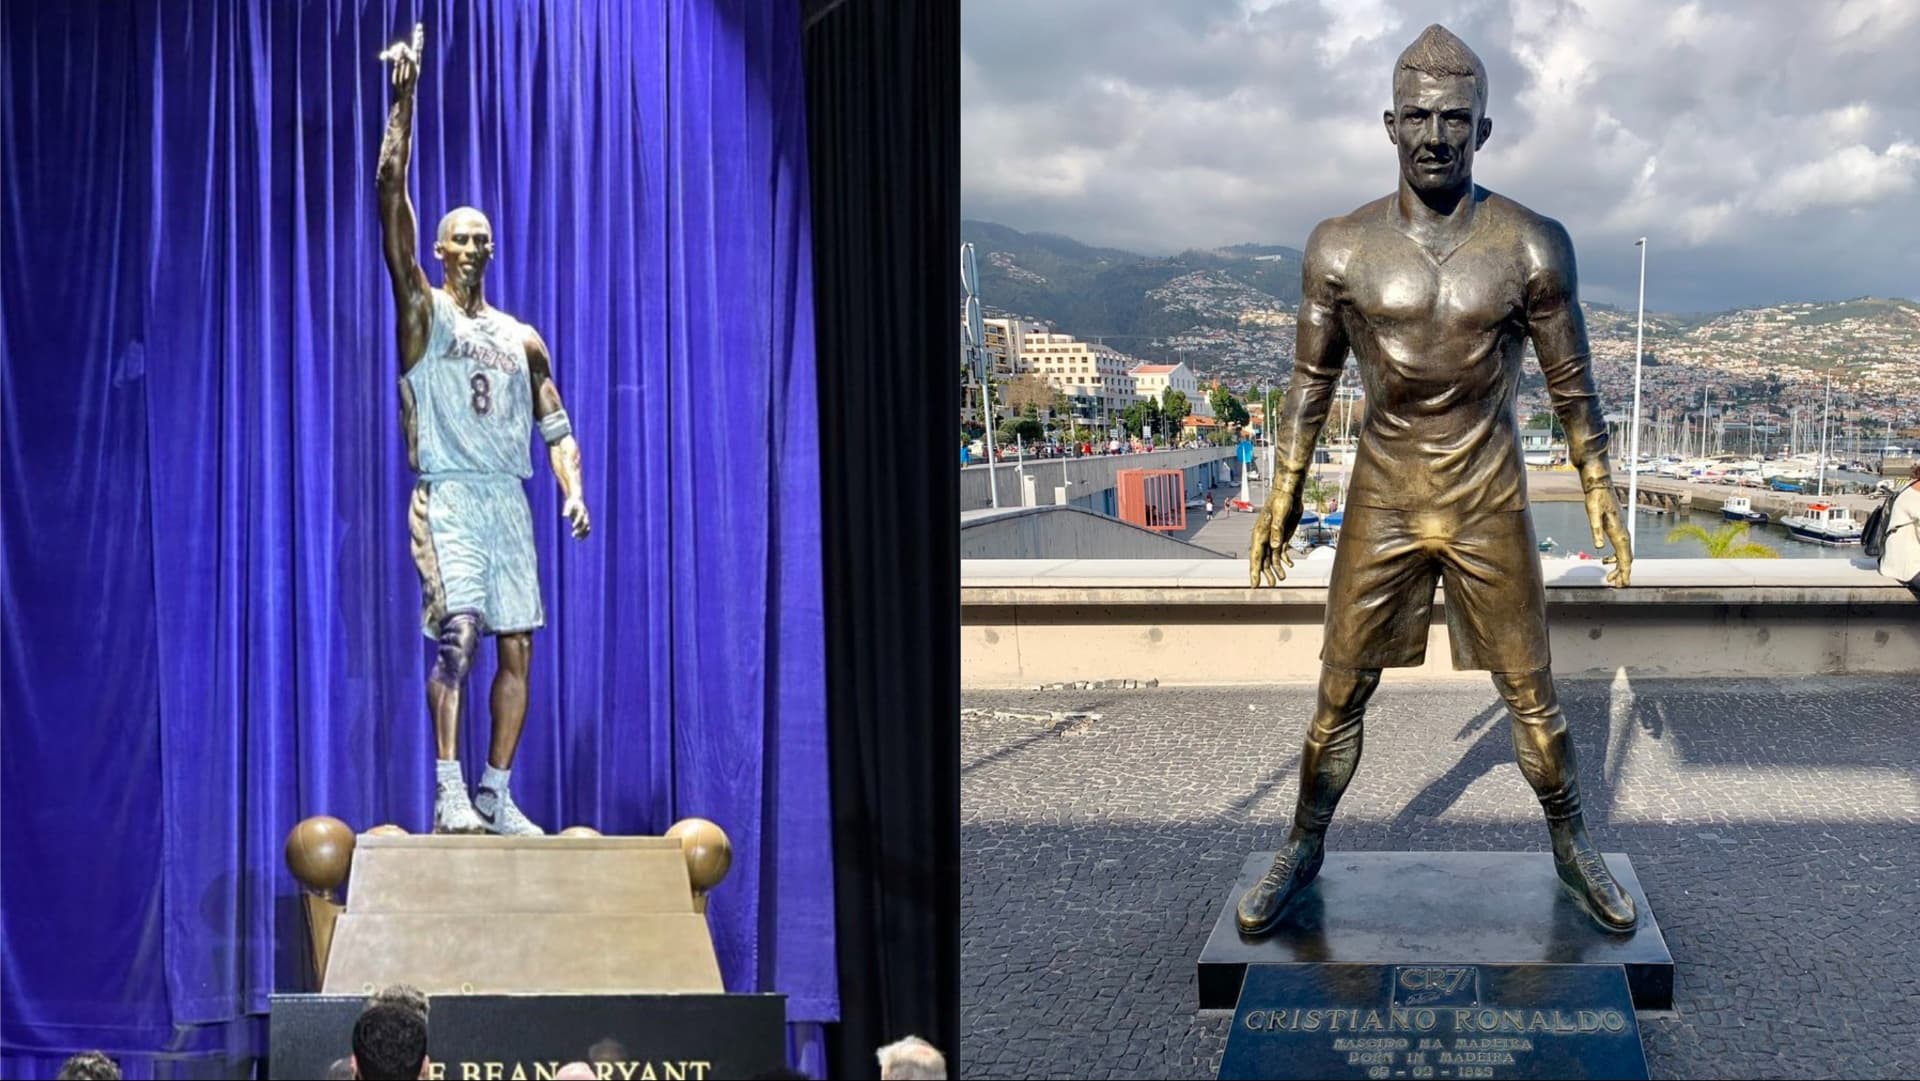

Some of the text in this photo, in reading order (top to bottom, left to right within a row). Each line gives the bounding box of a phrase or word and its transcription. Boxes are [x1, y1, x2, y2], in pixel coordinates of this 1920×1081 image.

[470, 372, 493, 416] 8
[1401, 967, 1466, 994] CR7
[1245, 1008, 1625, 1033] CRISTIANO RONALDO
[1455, 1038, 1532, 1050] MADEIRA
[1440, 1052, 1514, 1064] MADEIRA
[594, 1061, 710, 1080] RYANT
